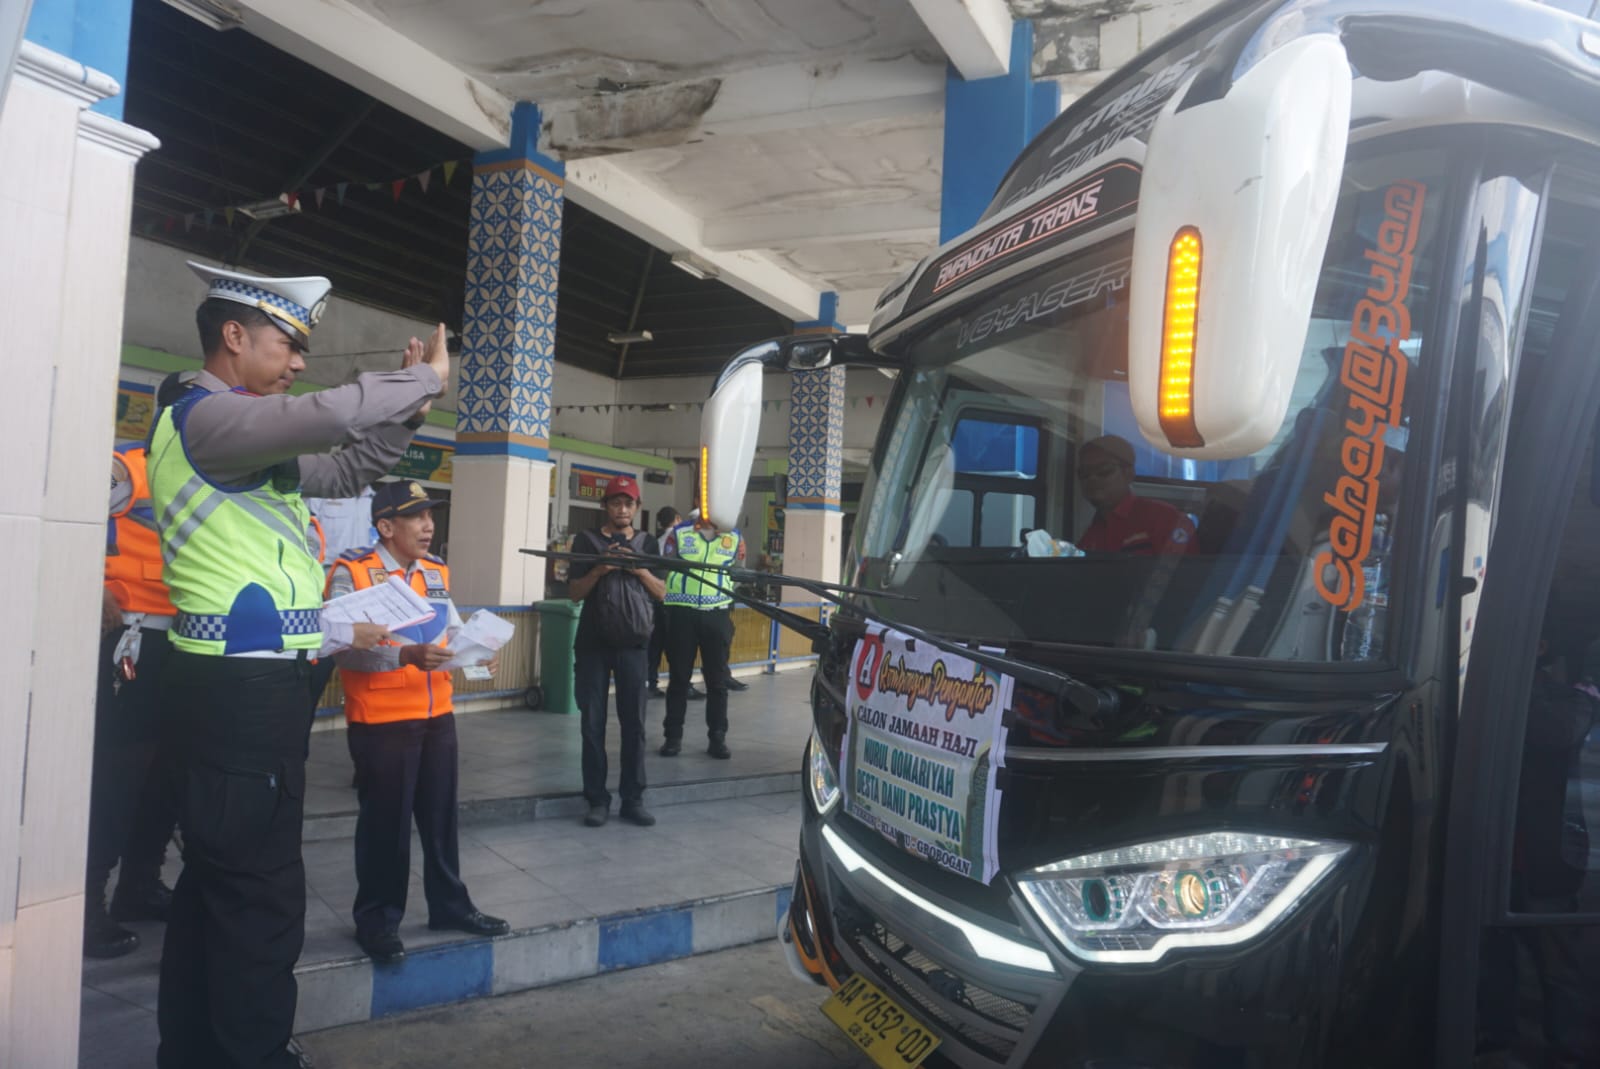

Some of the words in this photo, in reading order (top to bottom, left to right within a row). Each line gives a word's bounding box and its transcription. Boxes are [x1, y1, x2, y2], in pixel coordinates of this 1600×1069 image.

[1028, 185, 1103, 239] TRANS
[857, 705, 888, 730] CALON
[888, 716, 940, 747] JAMAAH
[941, 730, 978, 759] HAJI
[864, 737, 889, 772] NURUL
[890, 748, 955, 799] QOMARIYAH
[857, 768, 880, 804] DESTA
[908, 792, 961, 843] PRASTYA
[917, 839, 970, 875] GROBOGAN
[835, 977, 868, 1008] AA
[856, 993, 905, 1040] 7652
